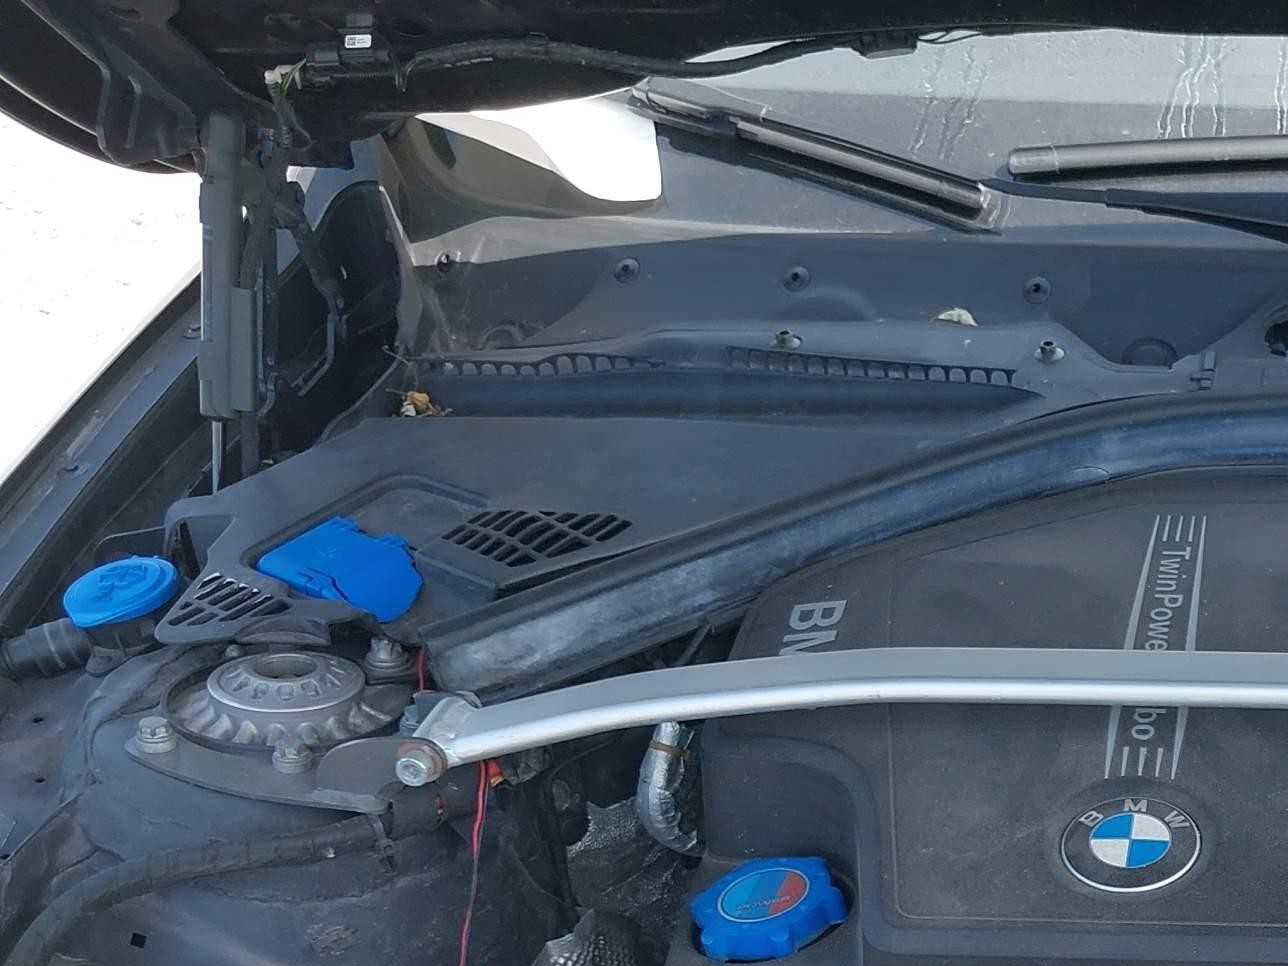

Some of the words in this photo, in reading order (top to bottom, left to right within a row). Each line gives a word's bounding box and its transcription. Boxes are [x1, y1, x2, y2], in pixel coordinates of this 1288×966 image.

[1144, 546, 1192, 651] TwinPowe
[779, 600, 847, 656] BM
[1078, 799, 1190, 829] BMW
